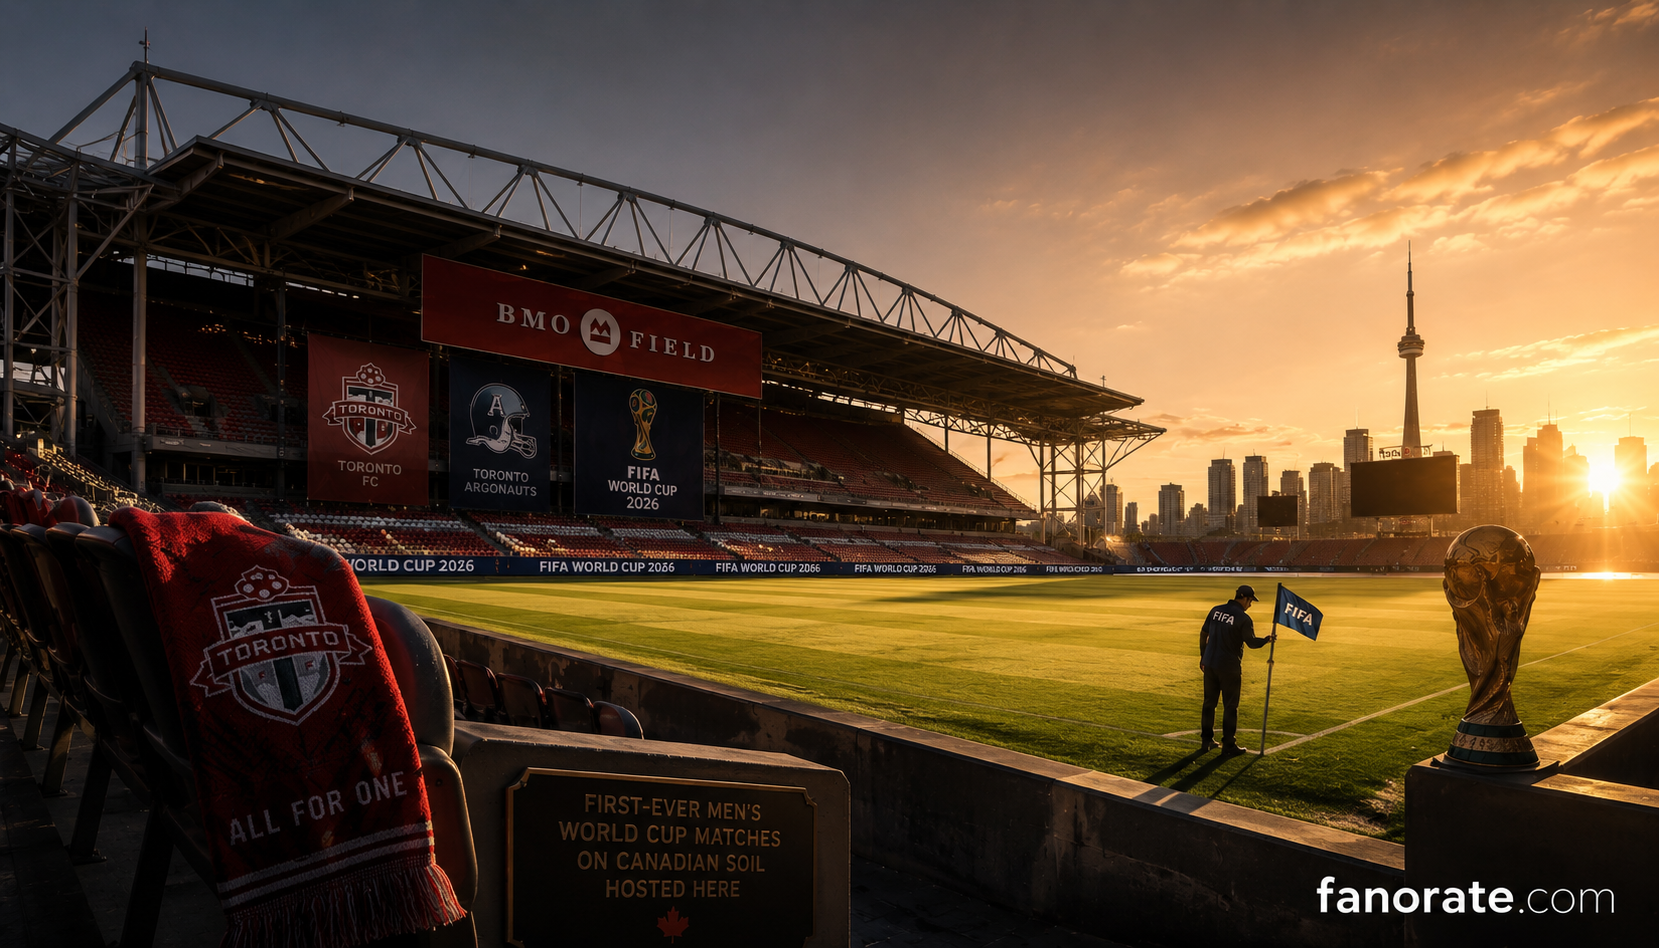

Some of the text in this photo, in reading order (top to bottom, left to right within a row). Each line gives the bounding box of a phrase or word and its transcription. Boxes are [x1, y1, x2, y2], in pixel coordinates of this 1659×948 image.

[496, 302, 715, 363] BMO FIELD
[338, 404, 402, 421] TORONTO
[337, 460, 402, 475] TORONTO
[473, 468, 529, 483] TORONTO
[627, 465, 660, 481] FIFA
[362, 475, 379, 487] FC
[464, 481, 538, 497] ARGONAUTS
[608, 479, 678, 496] WORLD CUP
[626, 496, 660, 511] 2026
[403, 559, 436, 572] CUP
[539, 561, 569, 573] FIFA
[572, 561, 619, 573] WORLD
[621, 561, 646, 573] CUP
[715, 563, 739, 573] FIFA
[740, 563, 777, 573] WORLD
[778, 563, 797, 573] CUP
[854, 564, 873, 573] FIFA
[874, 564, 902, 573] WORLD
[903, 564, 918, 573] CUP
[1213, 611, 1235, 626] FIFA
[1284, 602, 1313, 626] FIFA
[216, 630, 340, 666] TORONTO
[230, 771, 408, 846] ALL FOR ONE
[584, 793, 762, 821] FIRST-EVER MEN'S
[558, 821, 781, 847] WORLD CUP MATCHES
[577, 851, 766, 873] ON CANADIAN SOIL
[605, 879, 741, 898] HOSTED HERE
